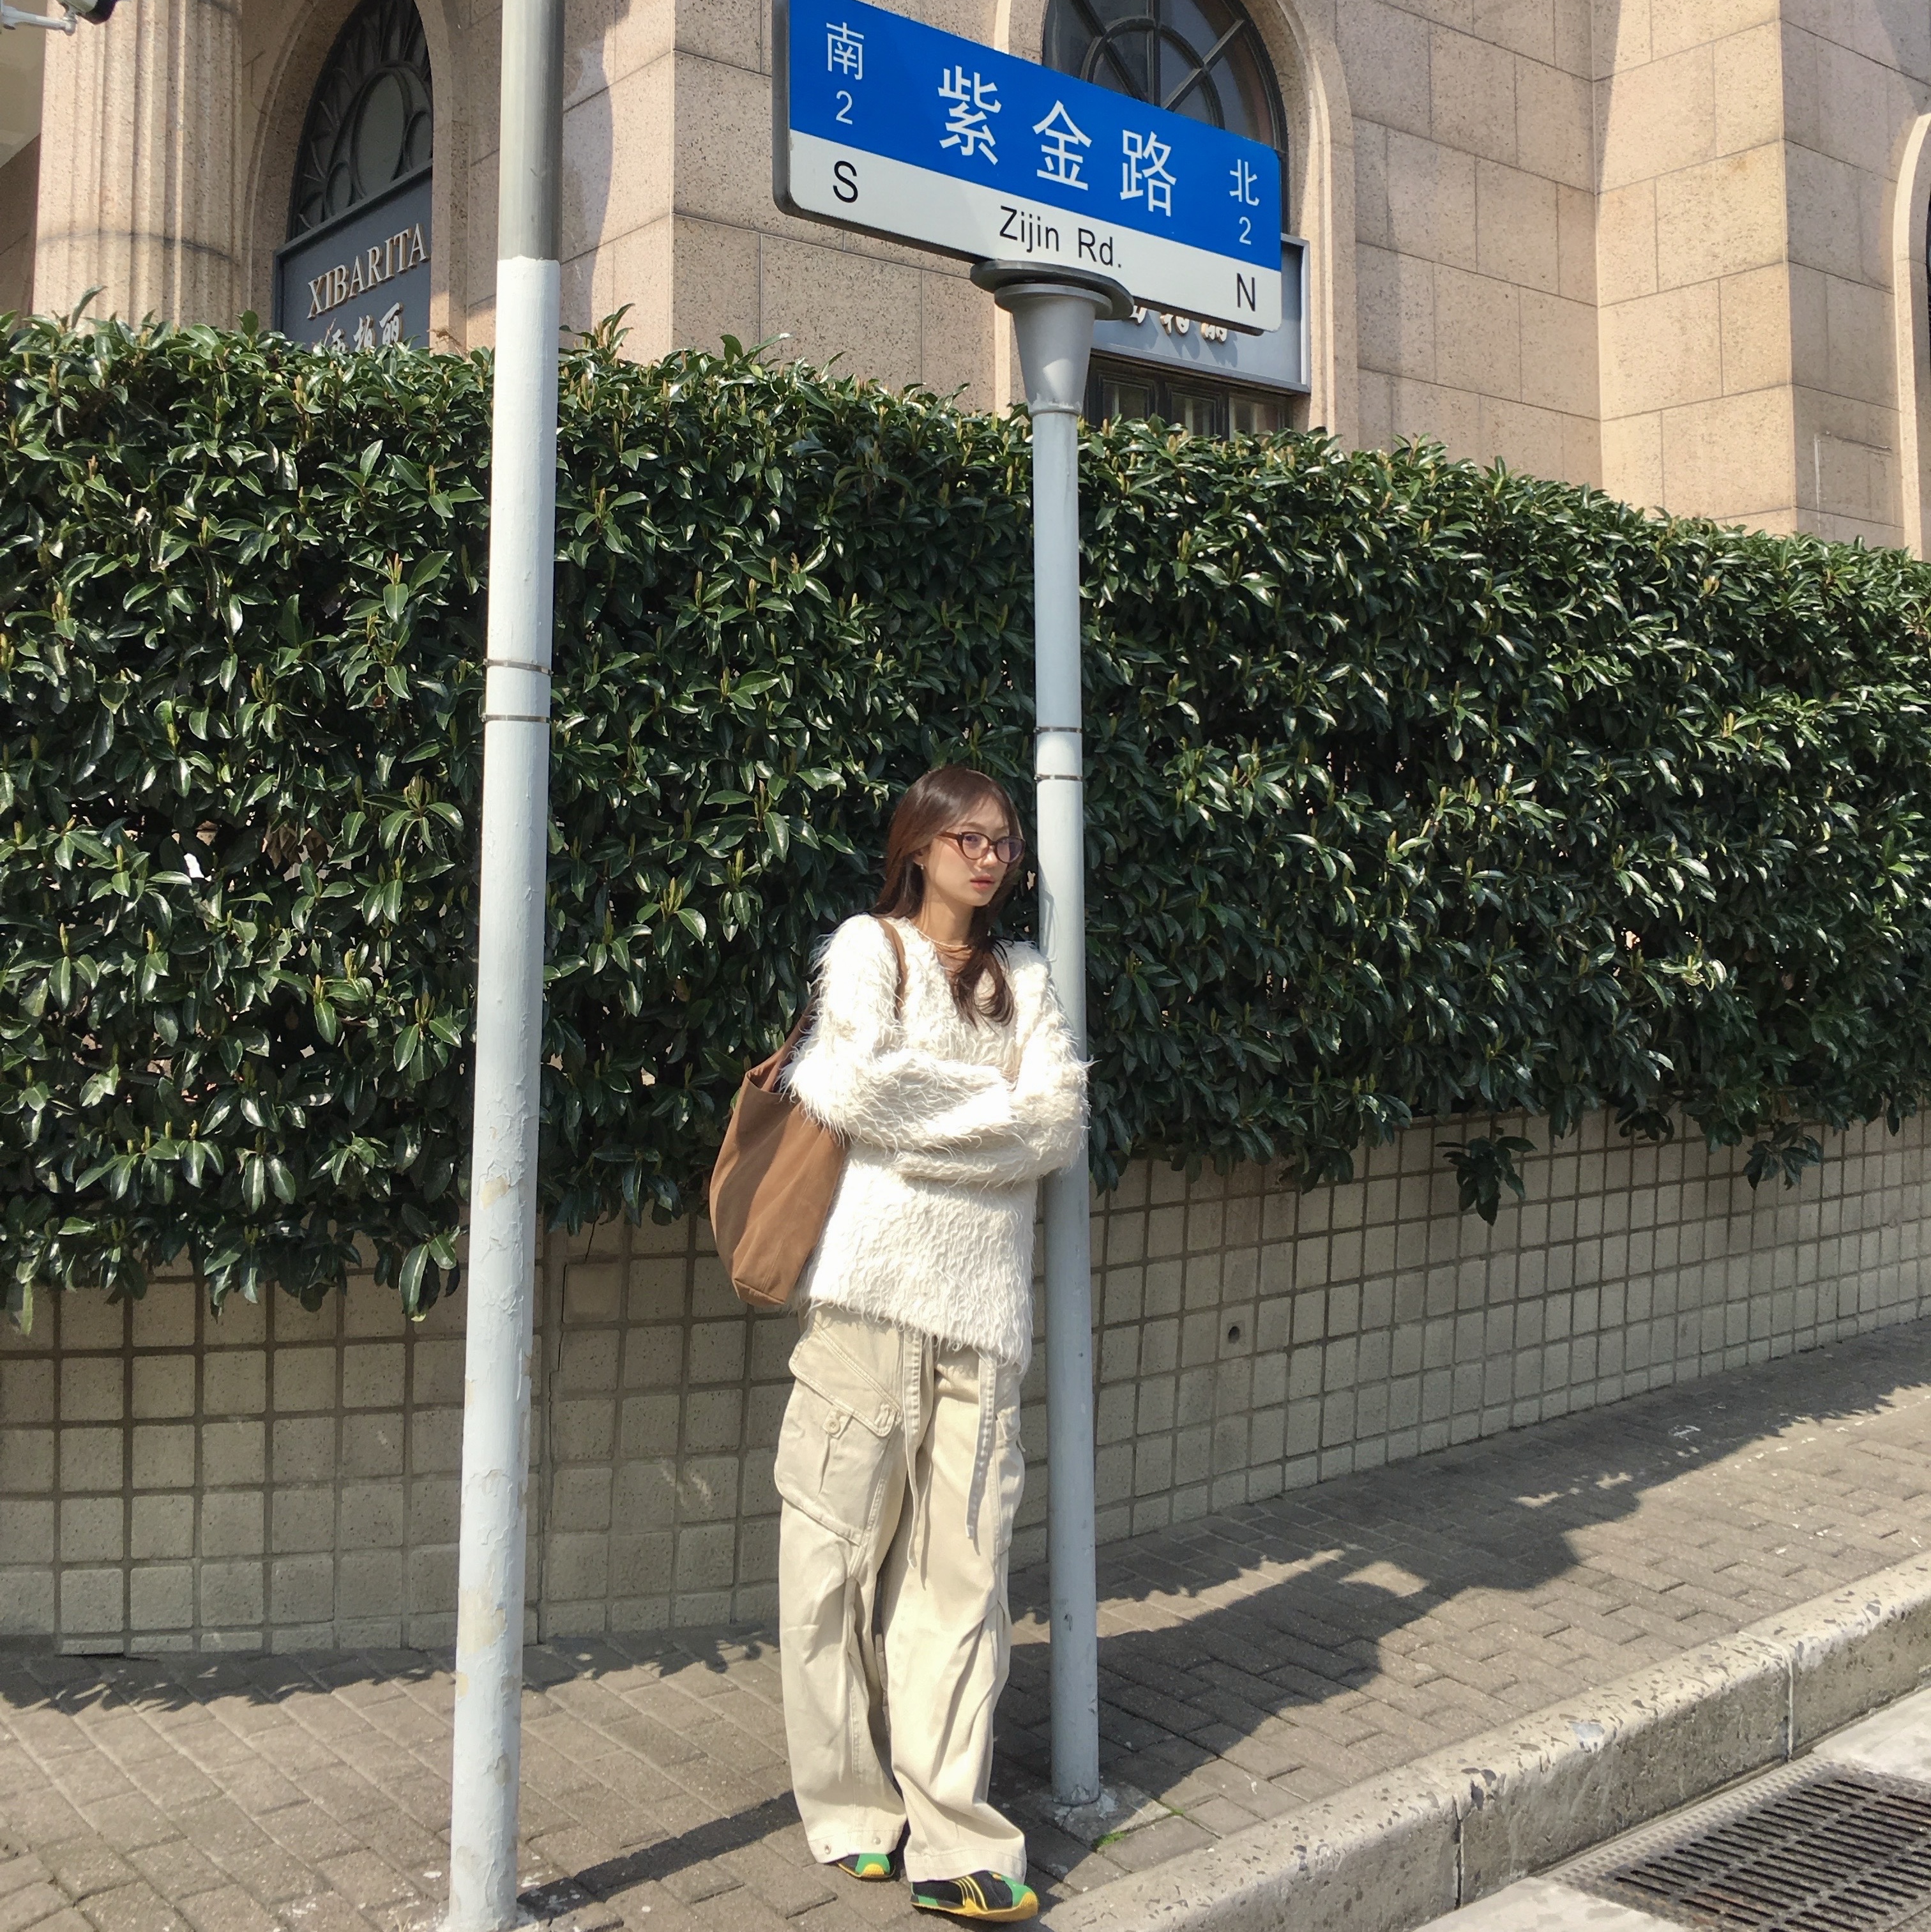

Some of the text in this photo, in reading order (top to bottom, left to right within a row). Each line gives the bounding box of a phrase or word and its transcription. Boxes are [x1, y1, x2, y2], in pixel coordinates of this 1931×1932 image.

[826, 22, 865, 80] 南
[835, 90, 853, 125] 2
[937, 65, 1177, 217] 紫金路
[833, 160, 858, 203] S
[1229, 158, 1260, 206] 北
[999, 205, 1122, 268] Zijin Rd.
[1239, 216, 1252, 245] 2
[307, 223, 429, 320] XIBARITA
[1236, 273, 1255, 312] N
